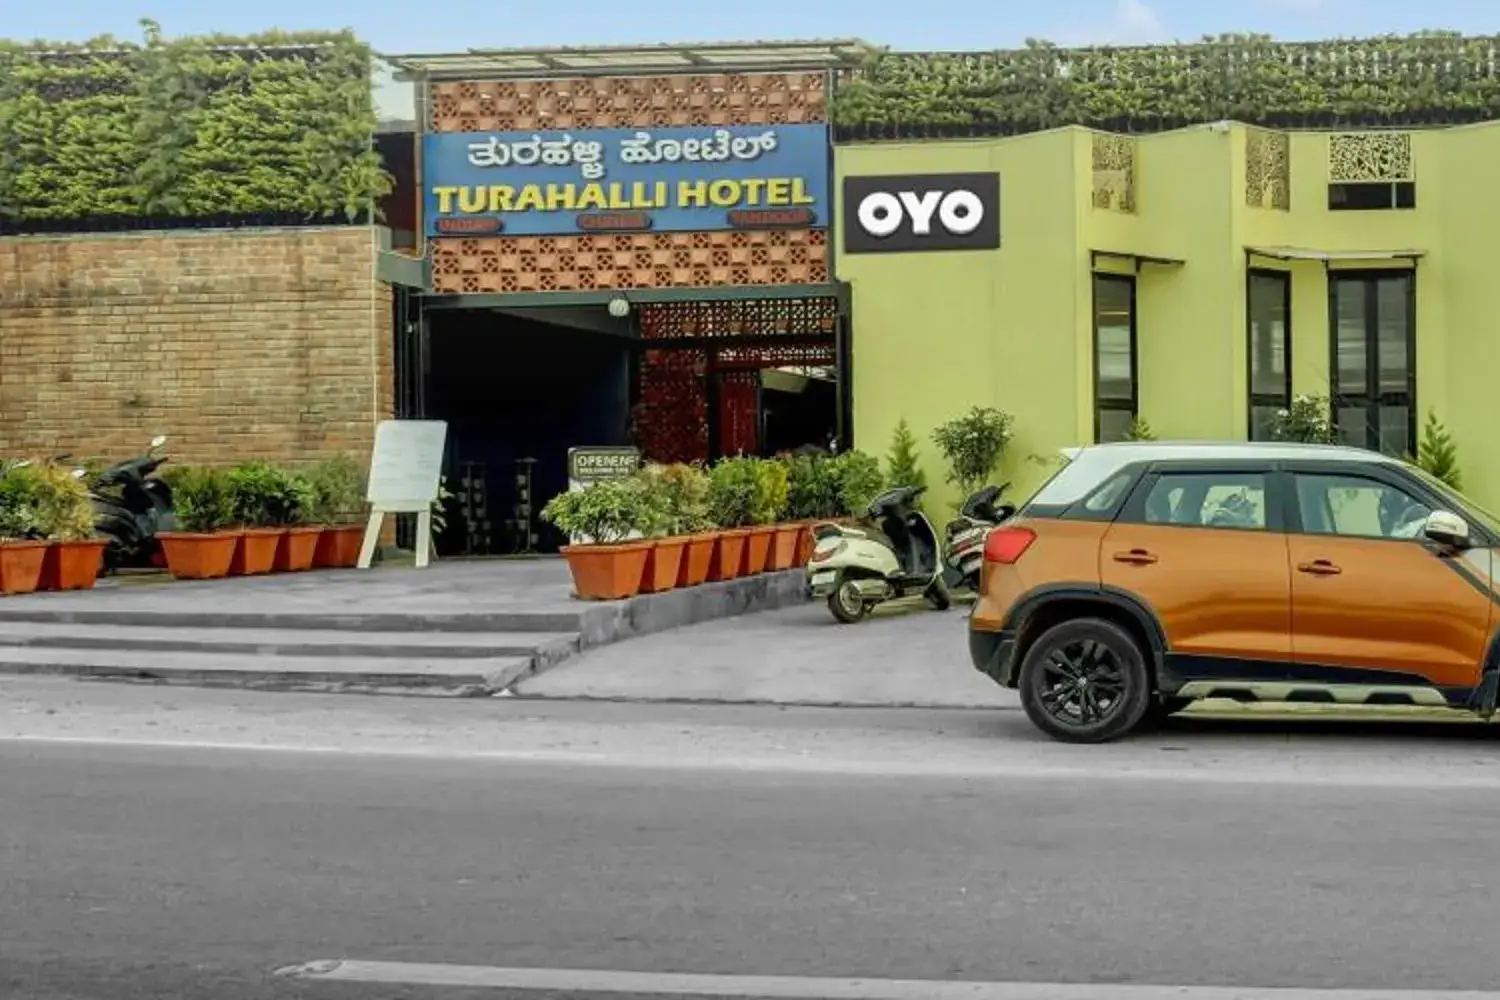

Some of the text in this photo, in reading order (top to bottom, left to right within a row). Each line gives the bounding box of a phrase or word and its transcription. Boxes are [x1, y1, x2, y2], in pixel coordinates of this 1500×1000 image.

[432, 177, 815, 215] TURAHALLI HOTEL
[857, 189, 985, 237] OYO
